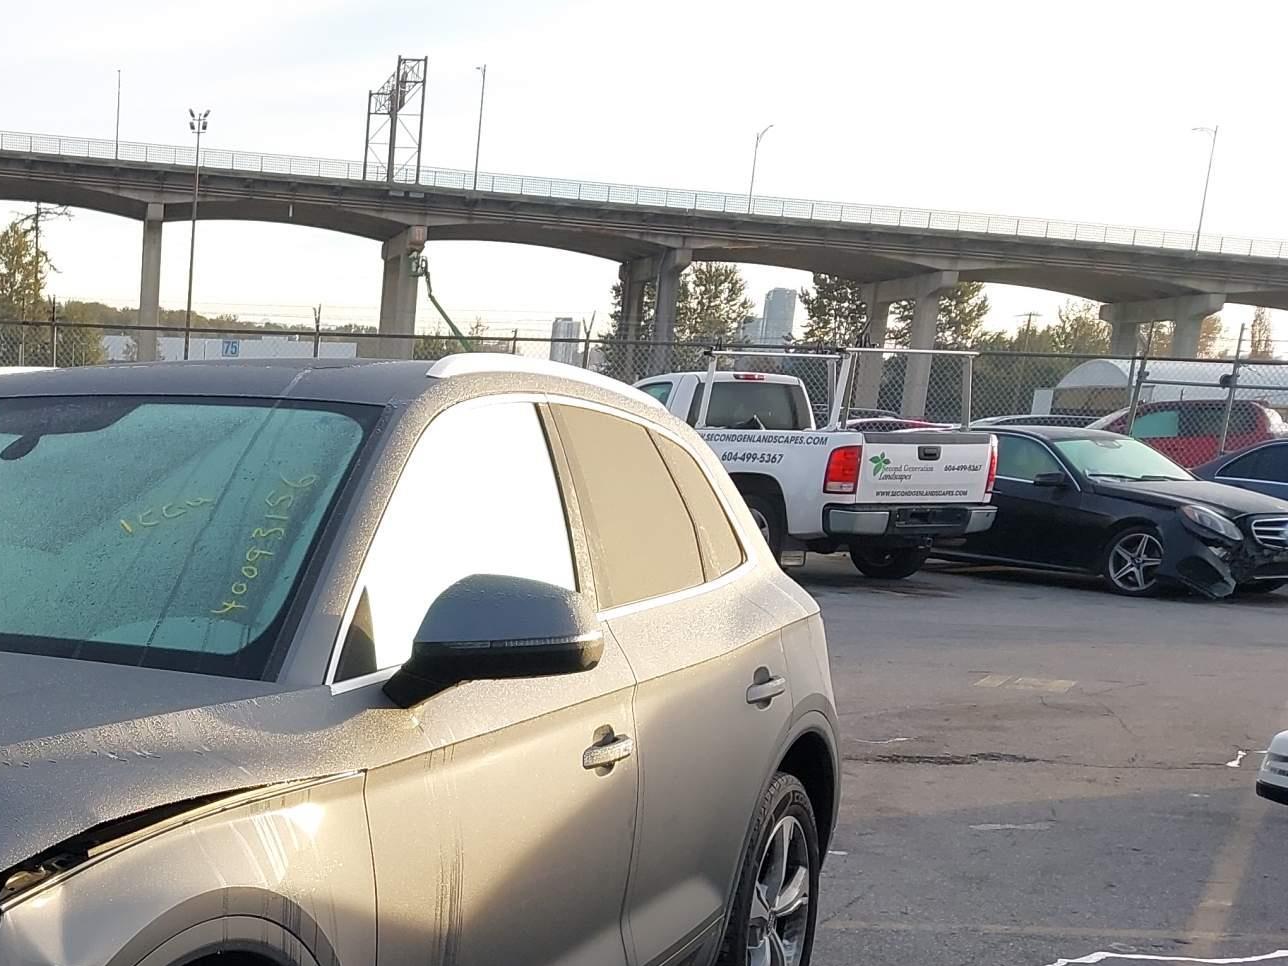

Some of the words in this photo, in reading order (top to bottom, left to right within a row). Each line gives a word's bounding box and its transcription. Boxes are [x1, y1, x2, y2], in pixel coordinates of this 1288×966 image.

[223, 340, 238, 355] 75
[721, 451, 784, 464] 604-499-5367
[211, 472, 320, 614] 40093156
